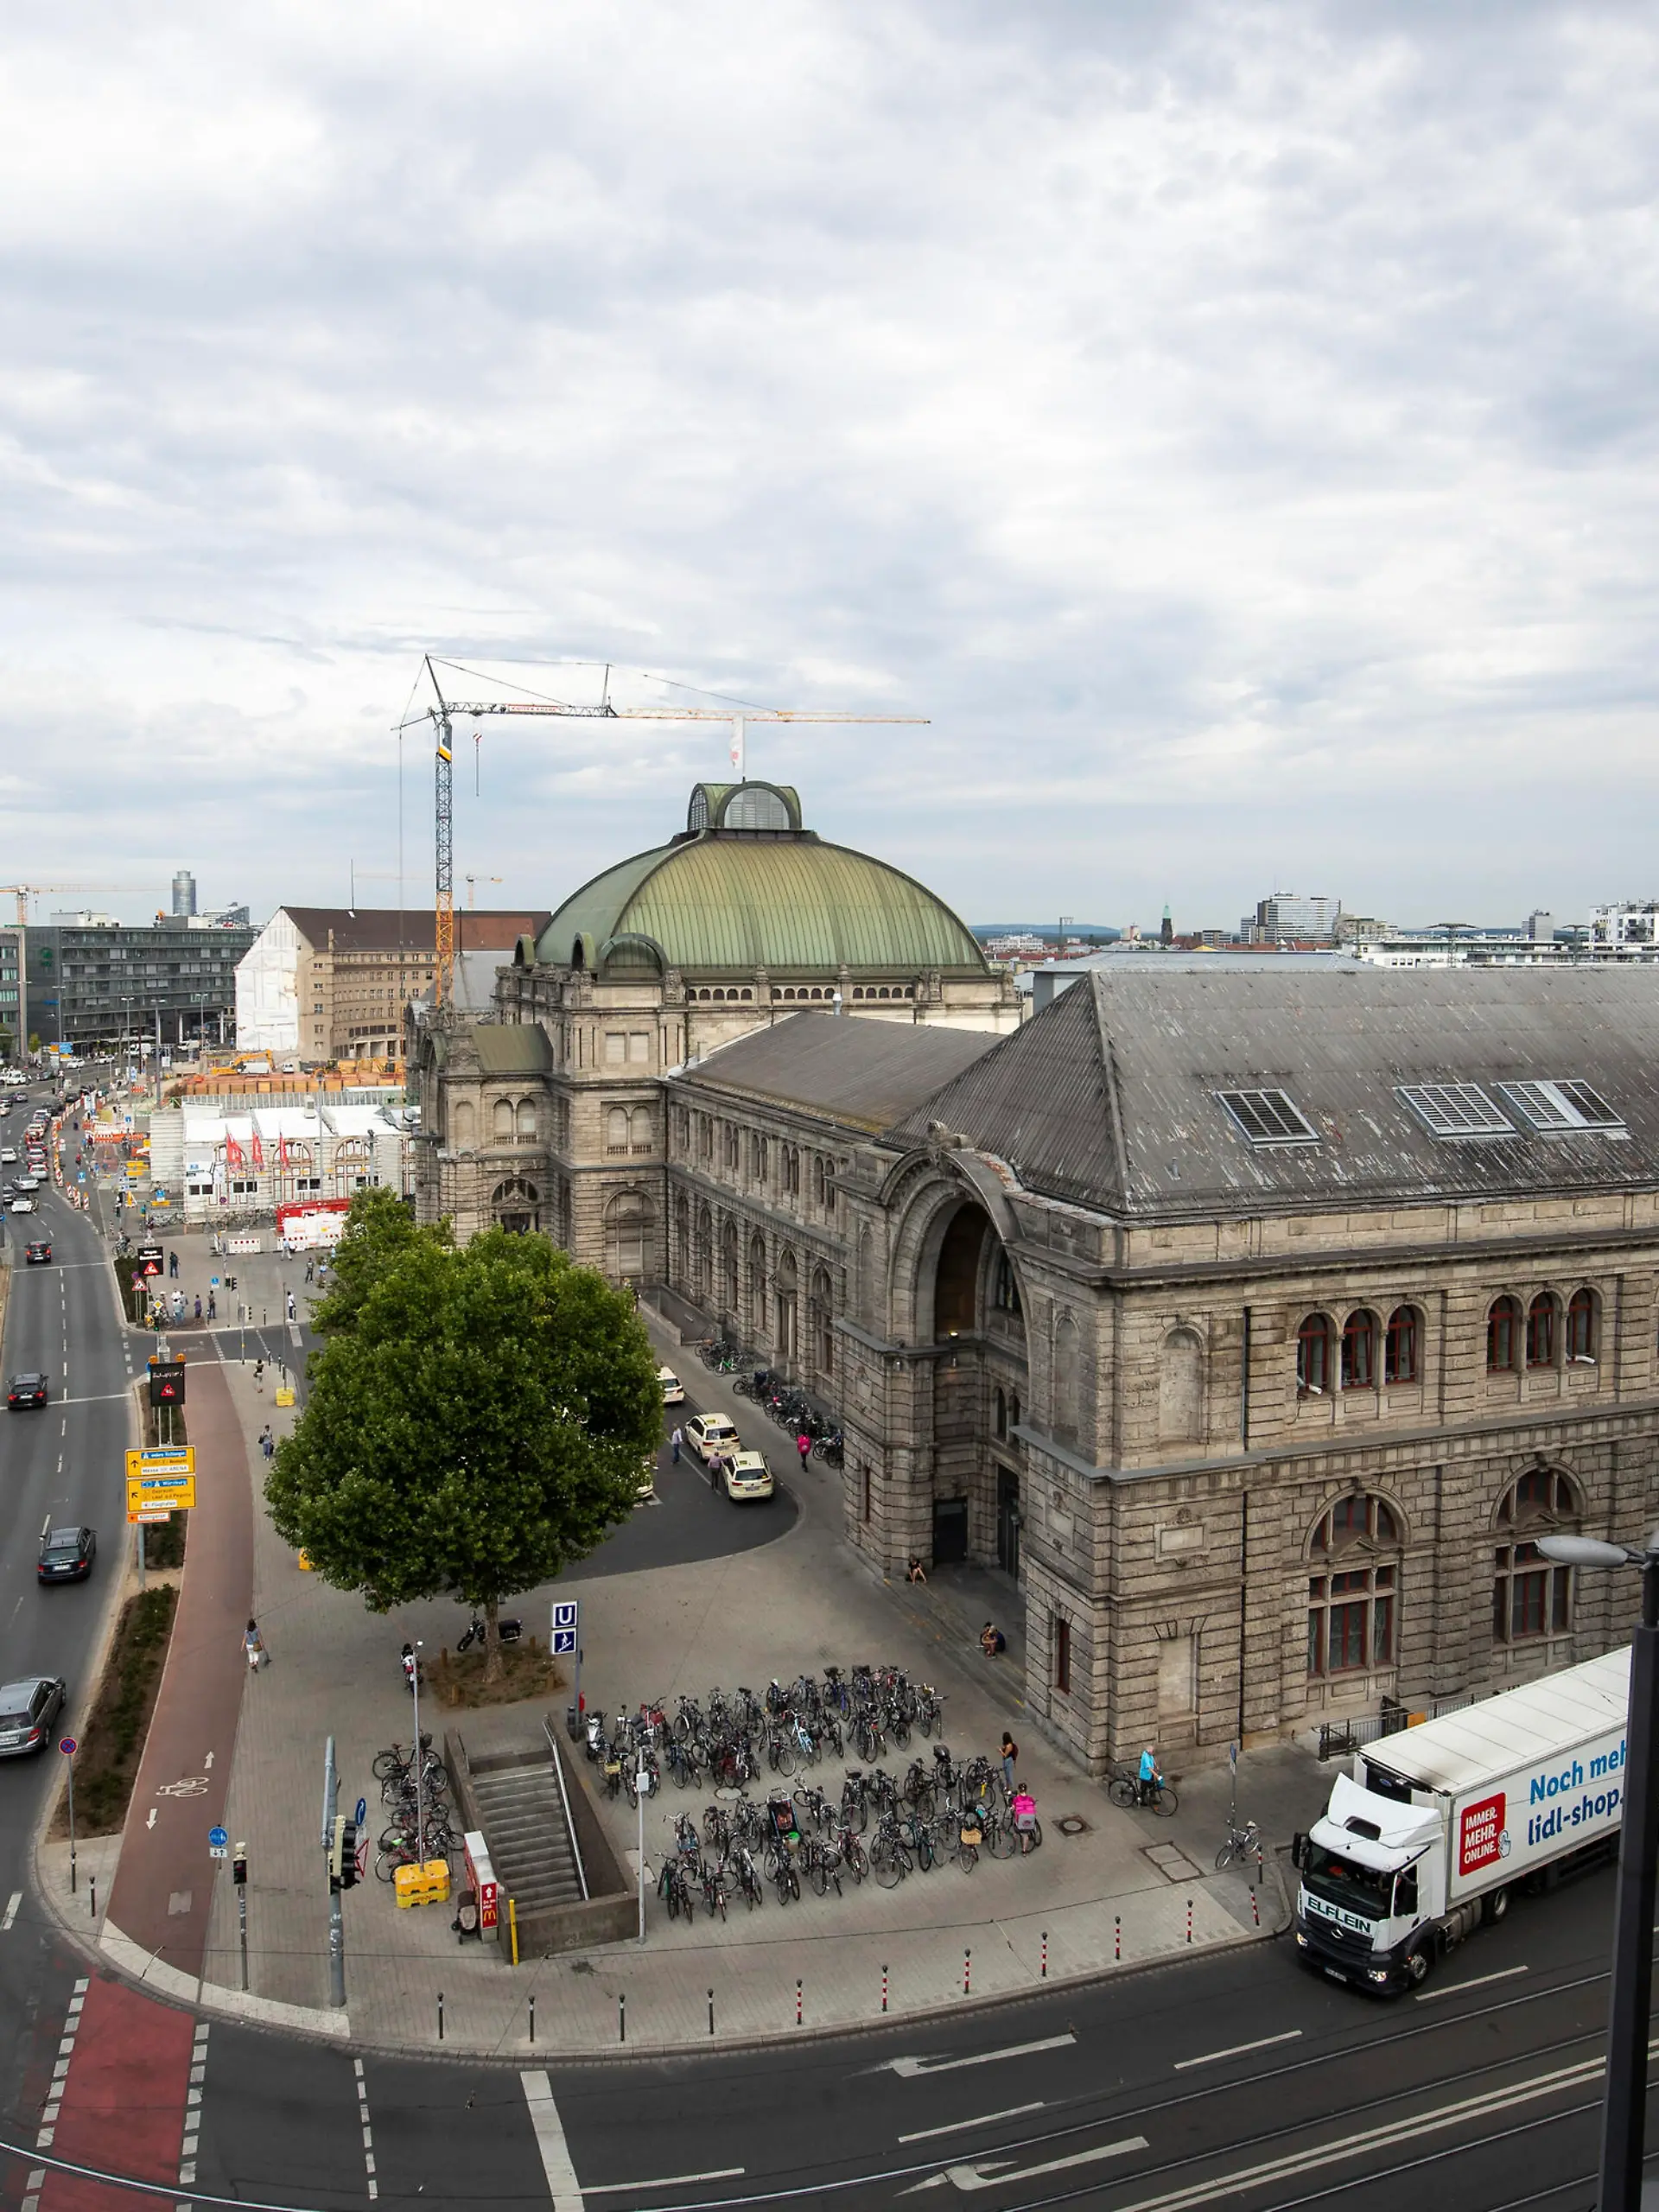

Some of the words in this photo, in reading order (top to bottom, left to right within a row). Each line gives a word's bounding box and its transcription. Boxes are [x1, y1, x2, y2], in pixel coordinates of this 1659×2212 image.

[558, 1606, 573, 1624] U
[1529, 1759, 1584, 1806] Noch
[1465, 1806, 1497, 1831] IMMER.
[1465, 1823, 1497, 1850] MEHR.
[1464, 1840, 1497, 1865] ONLINE.
[1307, 1896, 1371, 1934] ELFLEIN
